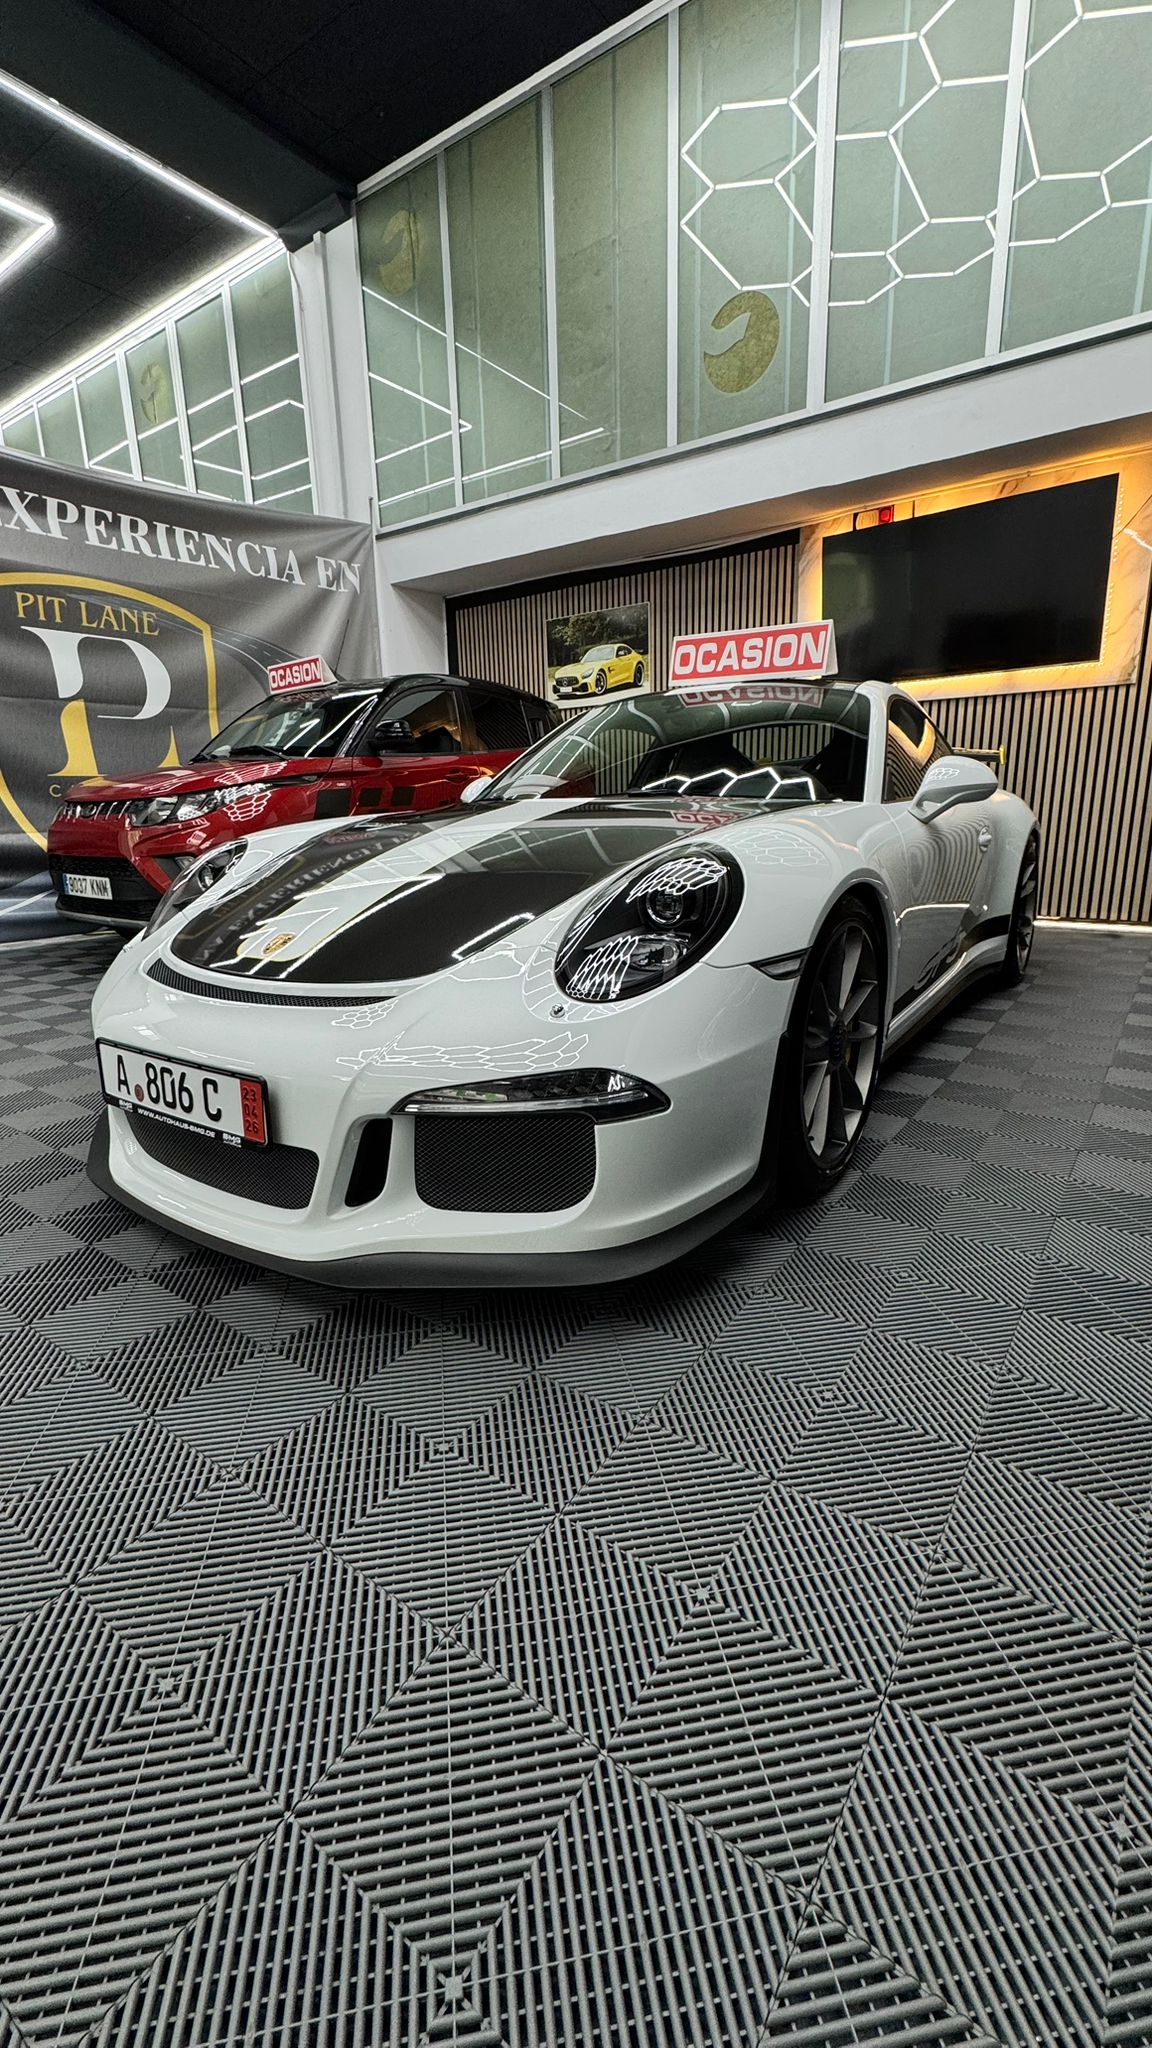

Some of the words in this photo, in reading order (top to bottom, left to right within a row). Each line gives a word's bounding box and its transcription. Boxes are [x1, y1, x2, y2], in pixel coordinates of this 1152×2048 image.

[0, 485, 306, 586] XPERIENCIA
[315, 555, 361, 595] EN
[15, 591, 66, 624] PIT
[80, 601, 161, 636] LANE
[673, 630, 826, 676] OCASION
[269, 660, 321, 689] OCASION
[69, 876, 87, 894] 9037
[117, 1054, 131, 1096] A
[145, 1062, 194, 1114] 806
[202, 1077, 222, 1122] C
[243, 1087, 257, 1102] 23
[244, 1103, 258, 1119] 04
[245, 1119, 259, 1135] 26
